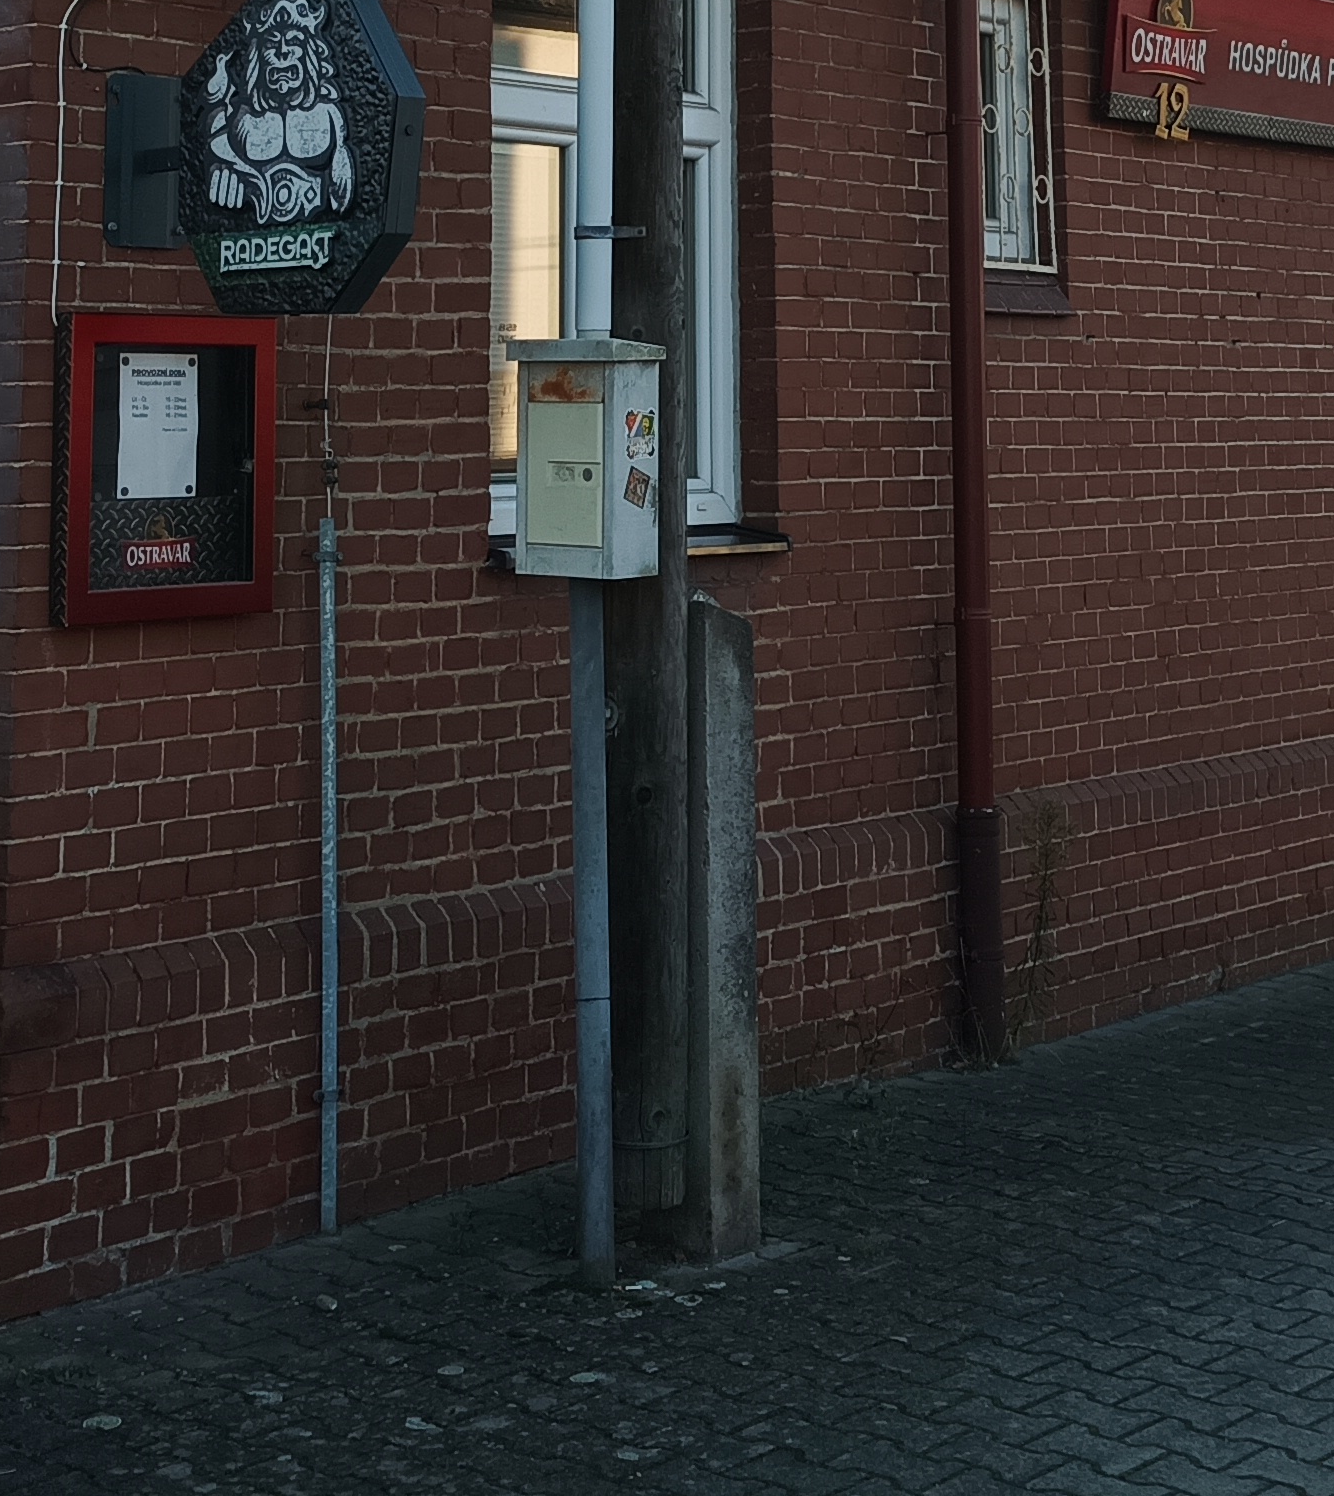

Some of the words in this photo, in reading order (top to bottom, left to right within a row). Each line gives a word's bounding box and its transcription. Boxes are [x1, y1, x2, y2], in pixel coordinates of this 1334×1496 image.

[1131, 28, 1207, 75] OSTRAVAR
[1229, 39, 1321, 86] HOSPŮDKA
[1153, 81, 1191, 142] 12
[220, 230, 336, 273] RADEGAST
[126, 542, 191, 567] OSTRAVAR
